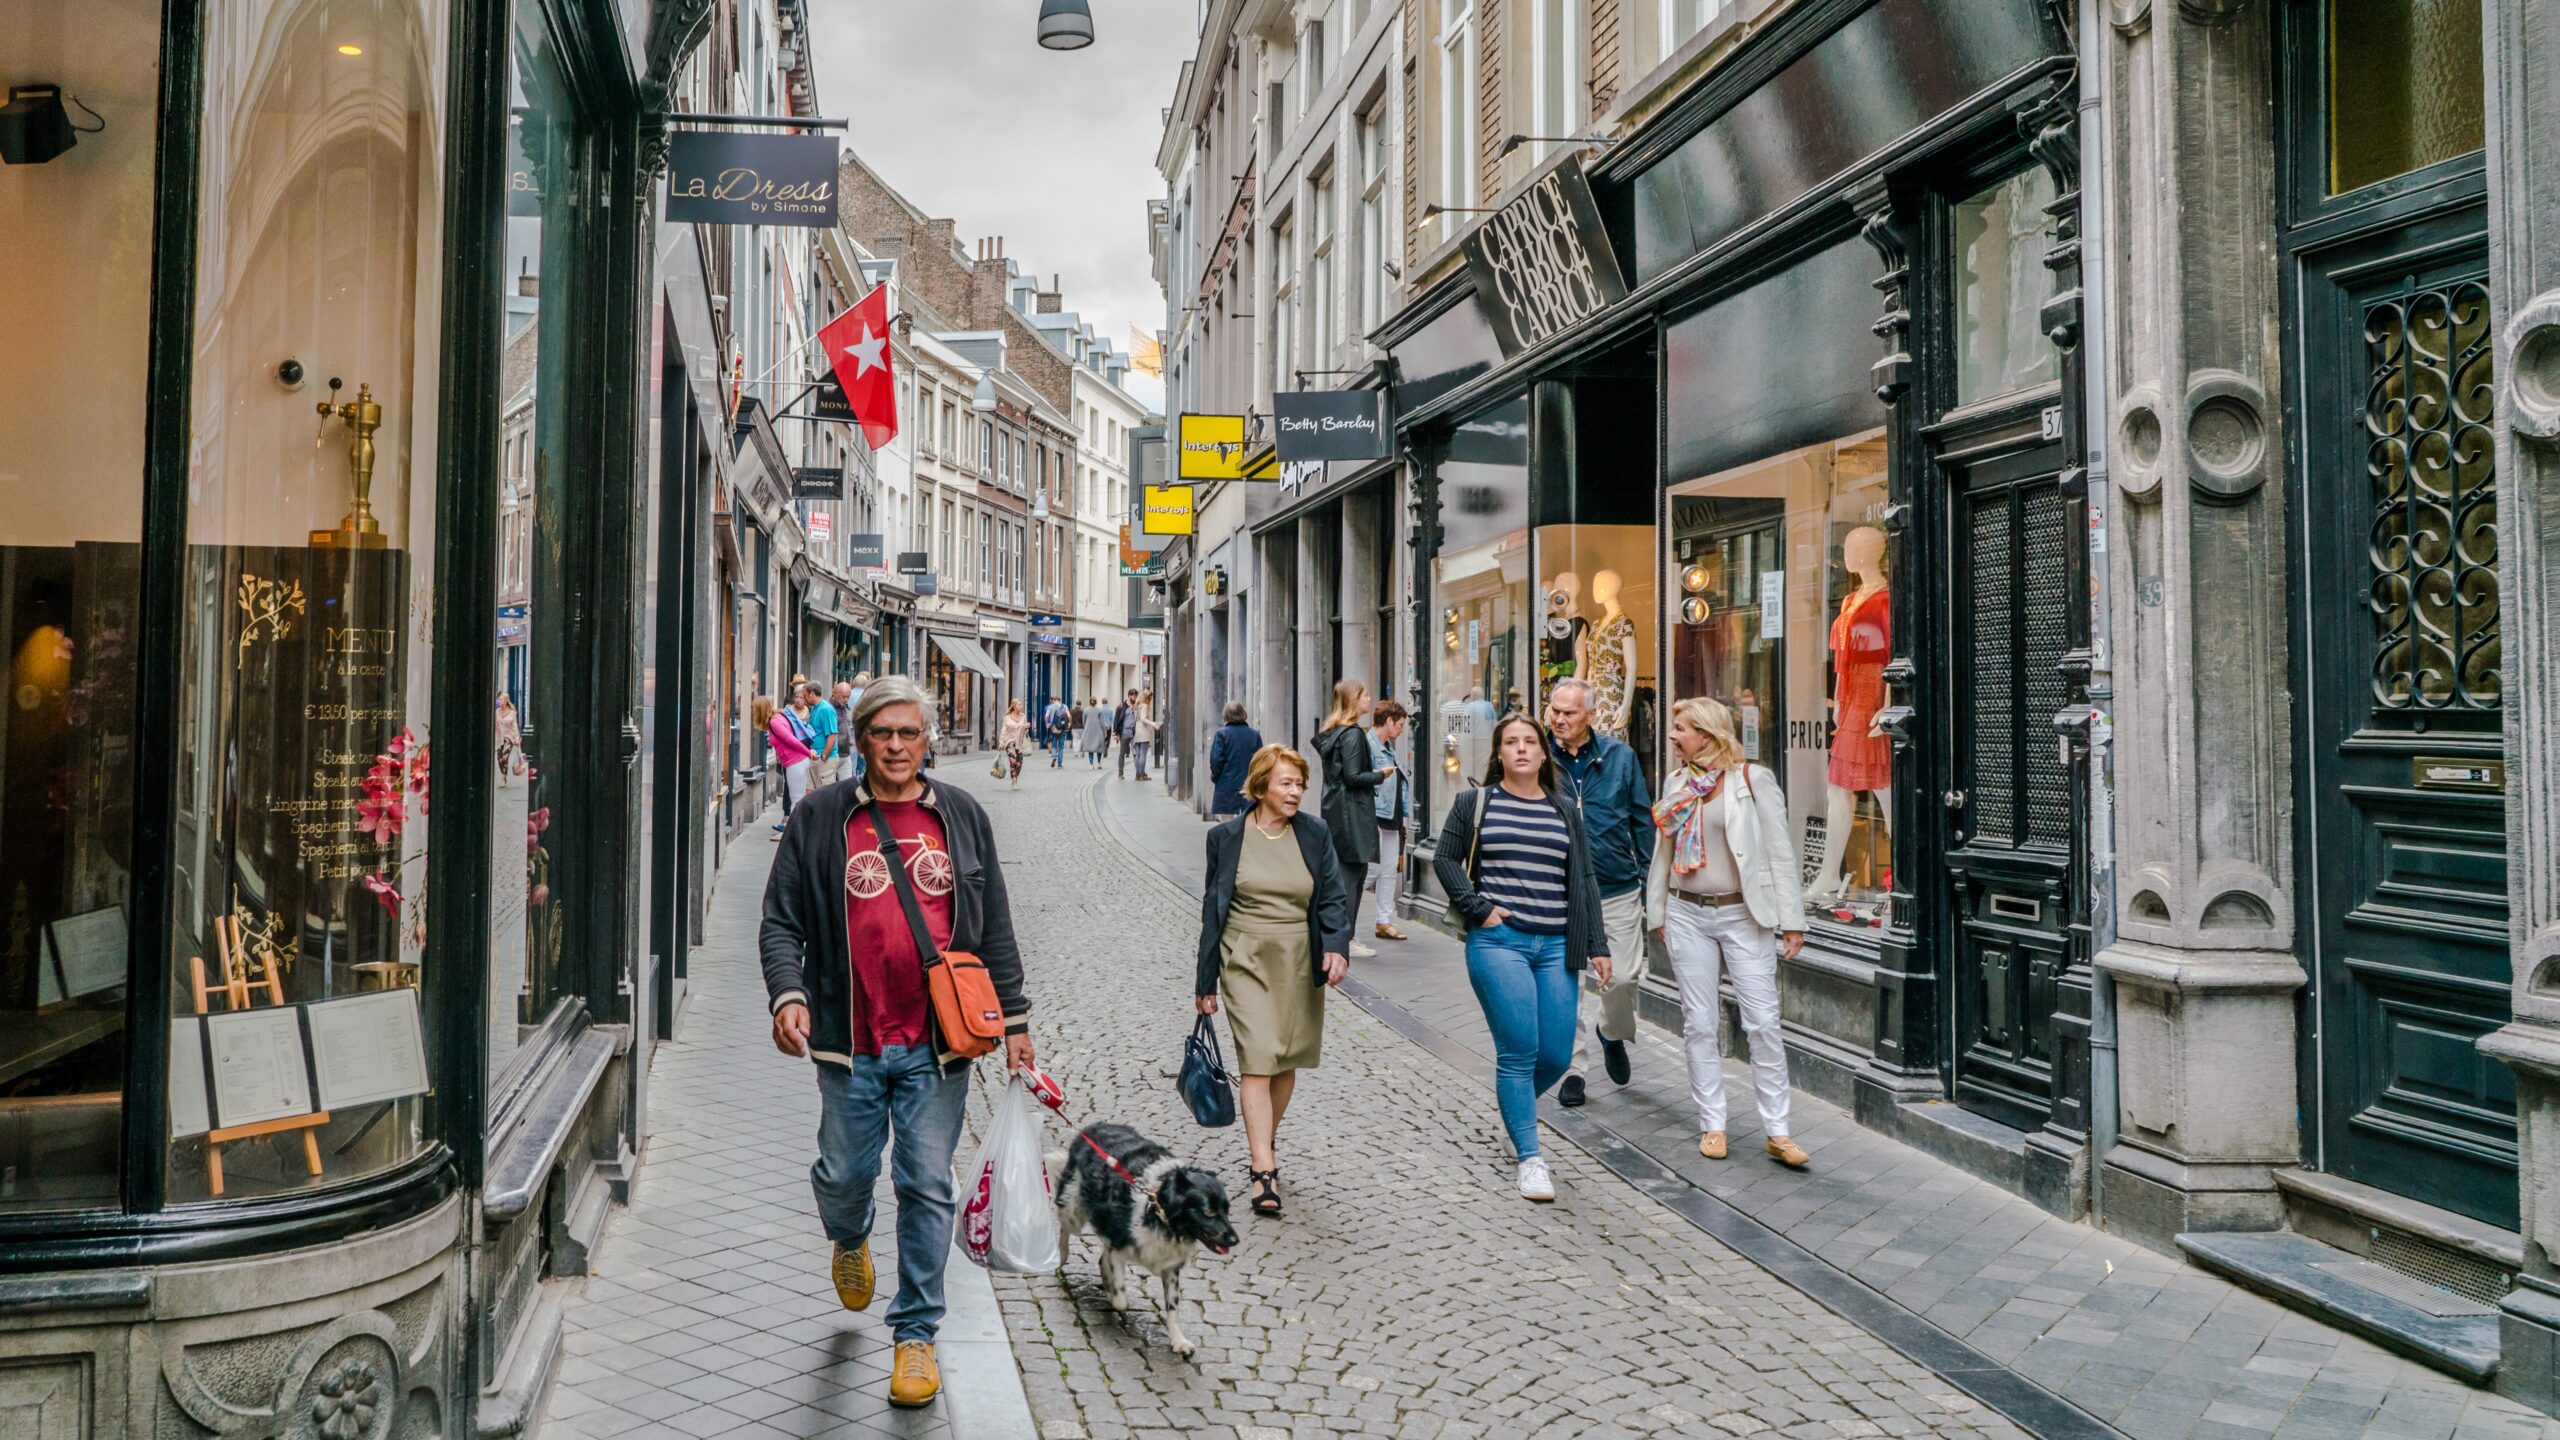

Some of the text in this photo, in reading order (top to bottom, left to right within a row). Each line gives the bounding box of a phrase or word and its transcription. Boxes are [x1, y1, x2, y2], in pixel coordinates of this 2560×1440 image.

[671, 167, 832, 201] La Dress
[751, 200, 827, 214] by Simone
[1479, 171, 1577, 269] CAPRICE
[1494, 218, 1590, 309] CAPRICE
[1510, 263, 1606, 349] CAPRICE
[1279, 414, 1375, 435] Betty Barclay
[2045, 411, 2062, 436] 37
[1184, 440, 1239, 454] Intertys
[1147, 504, 1190, 516] Intertoys
[2143, 581, 2164, 605] 39
[326, 627, 396, 655] MENU
[347, 660, 357, 675] la
[360, 665, 386, 676] carte
[304, 704, 316, 719] €
[350, 709, 369, 725] per
[323, 749, 356, 764] Steak
[313, 771, 347, 788] Steak
[331, 799, 356, 810] met
[291, 818, 351, 838] Spaghetti
[300, 840, 358, 861] Spaghetti
[319, 863, 347, 879] Petit
